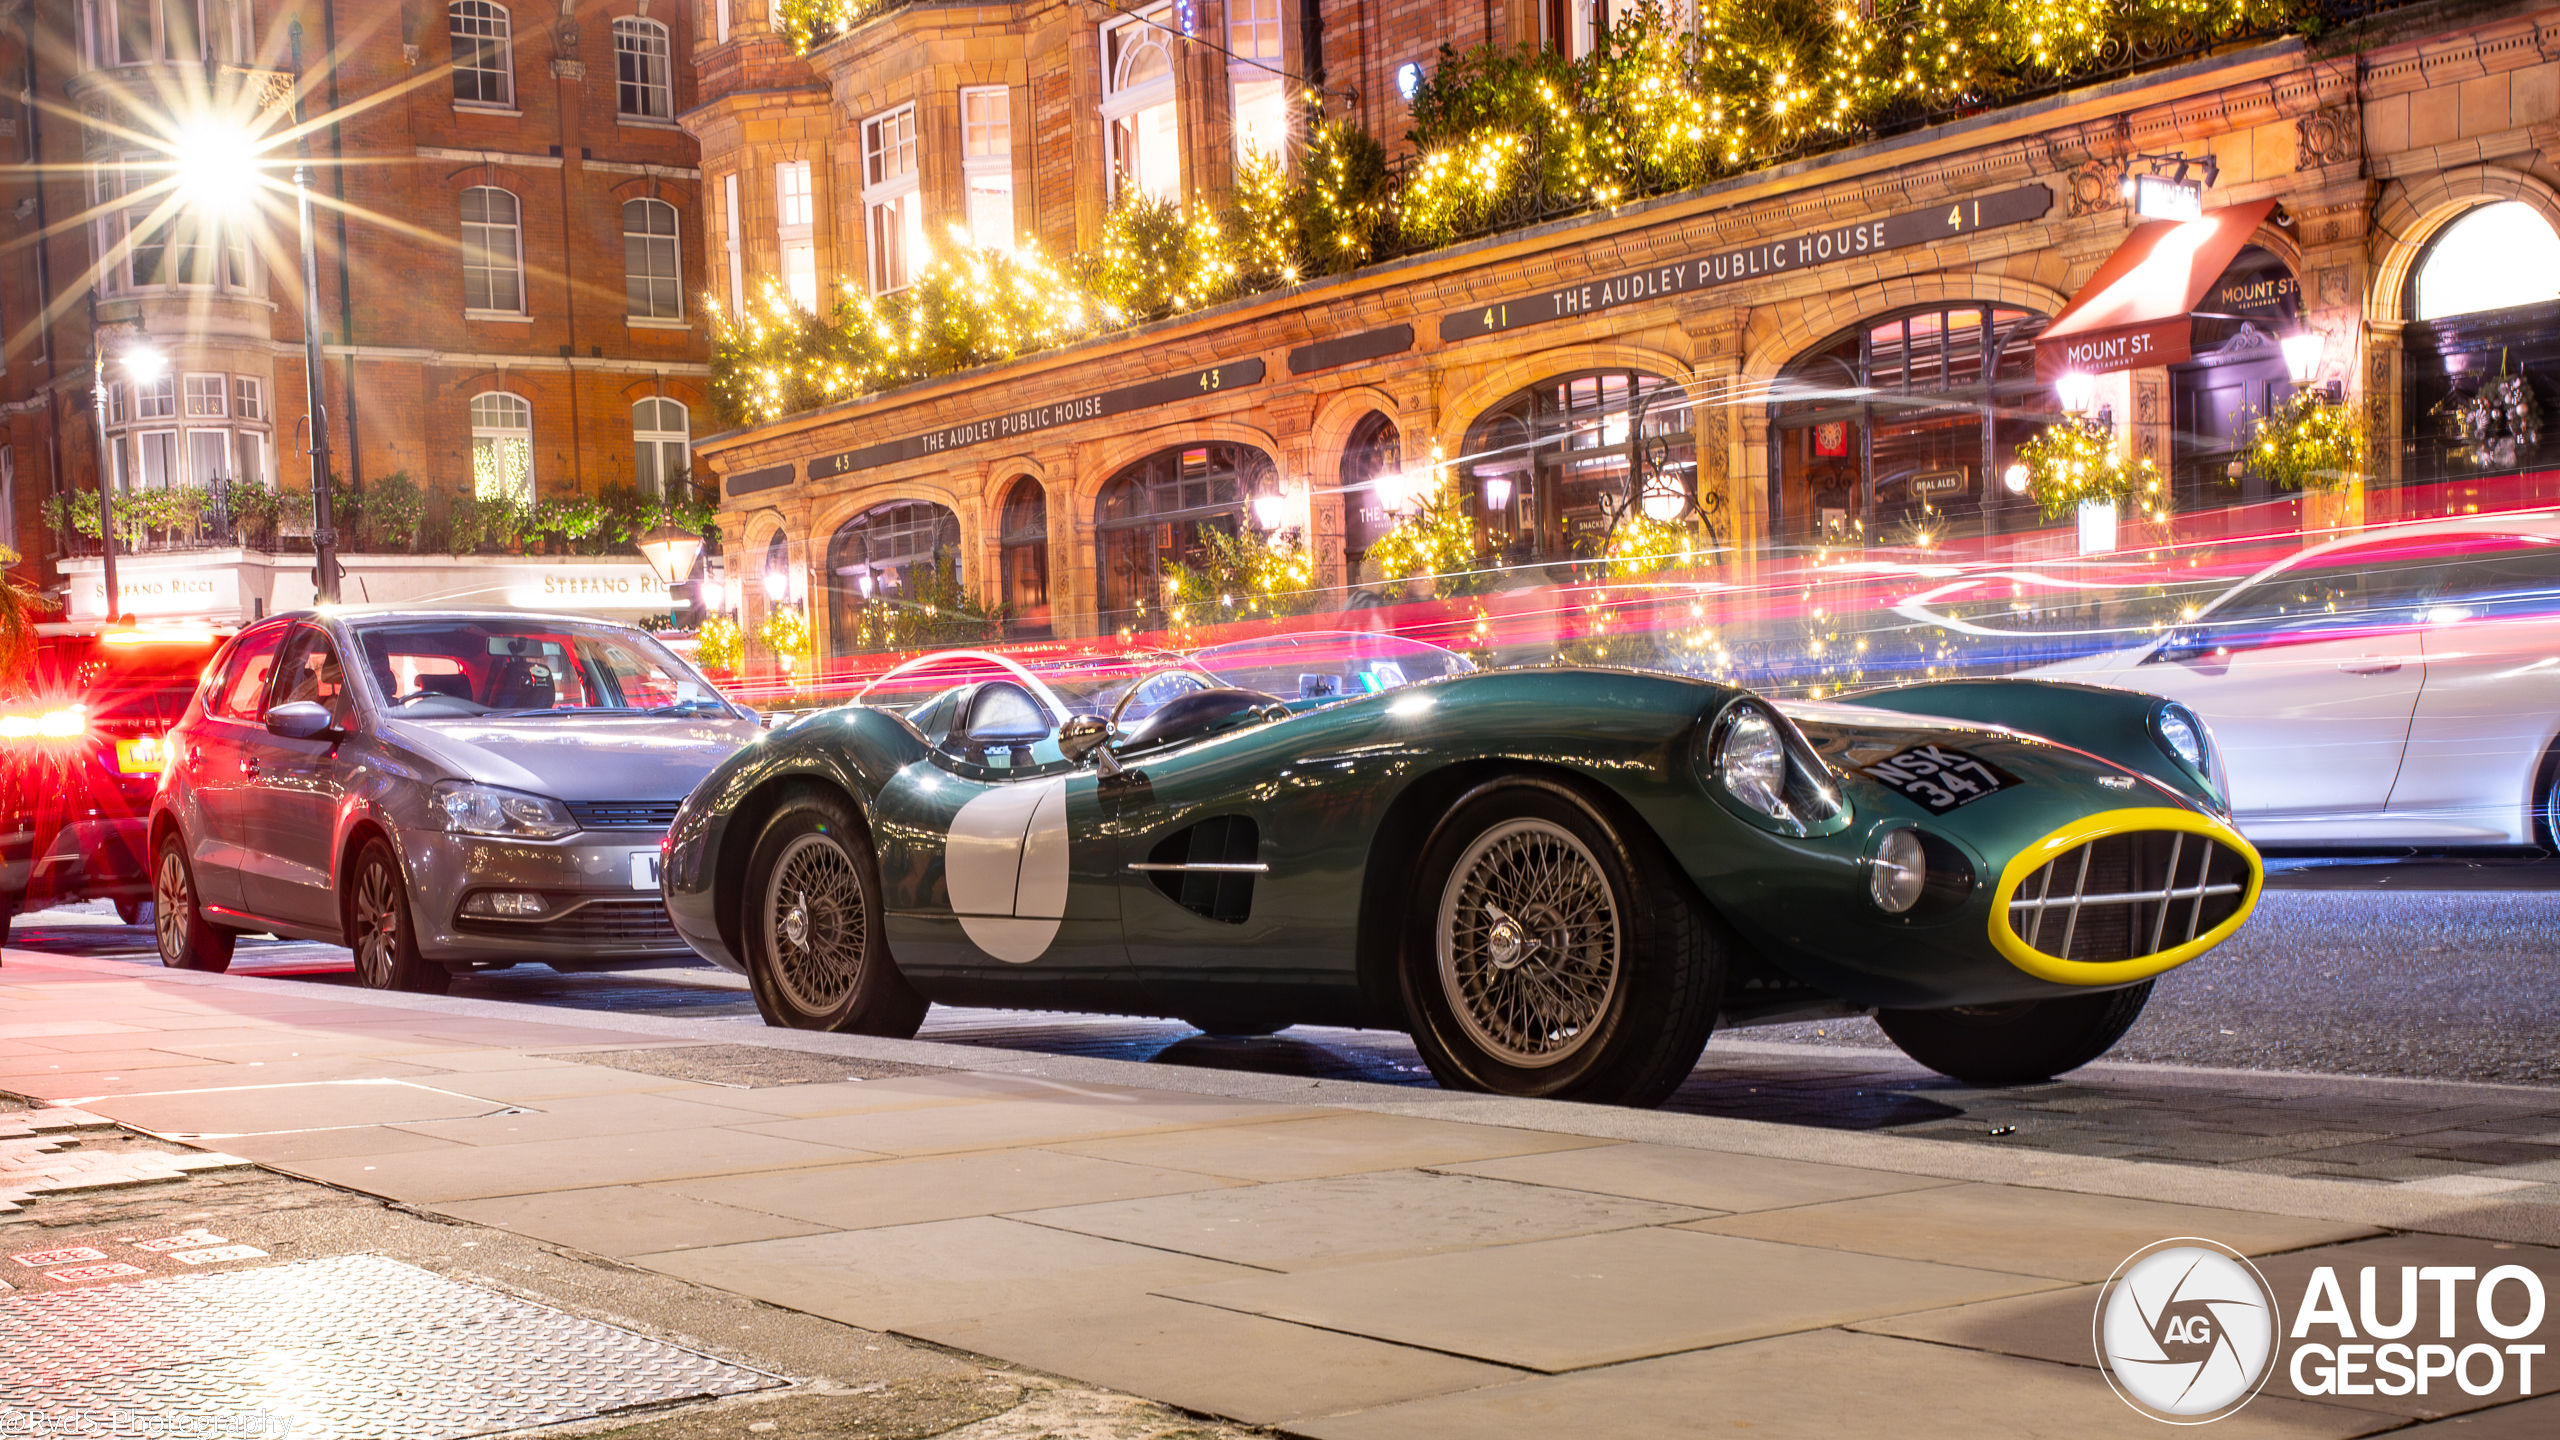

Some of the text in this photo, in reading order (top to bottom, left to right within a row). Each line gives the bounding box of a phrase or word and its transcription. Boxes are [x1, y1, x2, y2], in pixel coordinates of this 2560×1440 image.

[1483, 199, 1980, 330] 41 THE AUDLEY PUBLIC HOUSE 41
[2222, 277, 2298, 304] MOUNT ST.
[2068, 333, 2153, 364] MOUNT ST.
[835, 368, 1220, 472] 43 THE AUDLEY PUBLIC HOUSE 43
[1937, 477, 1956, 488] ALES
[1360, 507, 1380, 523] THE
[96, 580, 214, 598] SEFANO RICCI
[545, 577, 629, 593] STEFANO
[1863, 745, 1968, 786] NSK
[1906, 760, 2000, 807] 347
